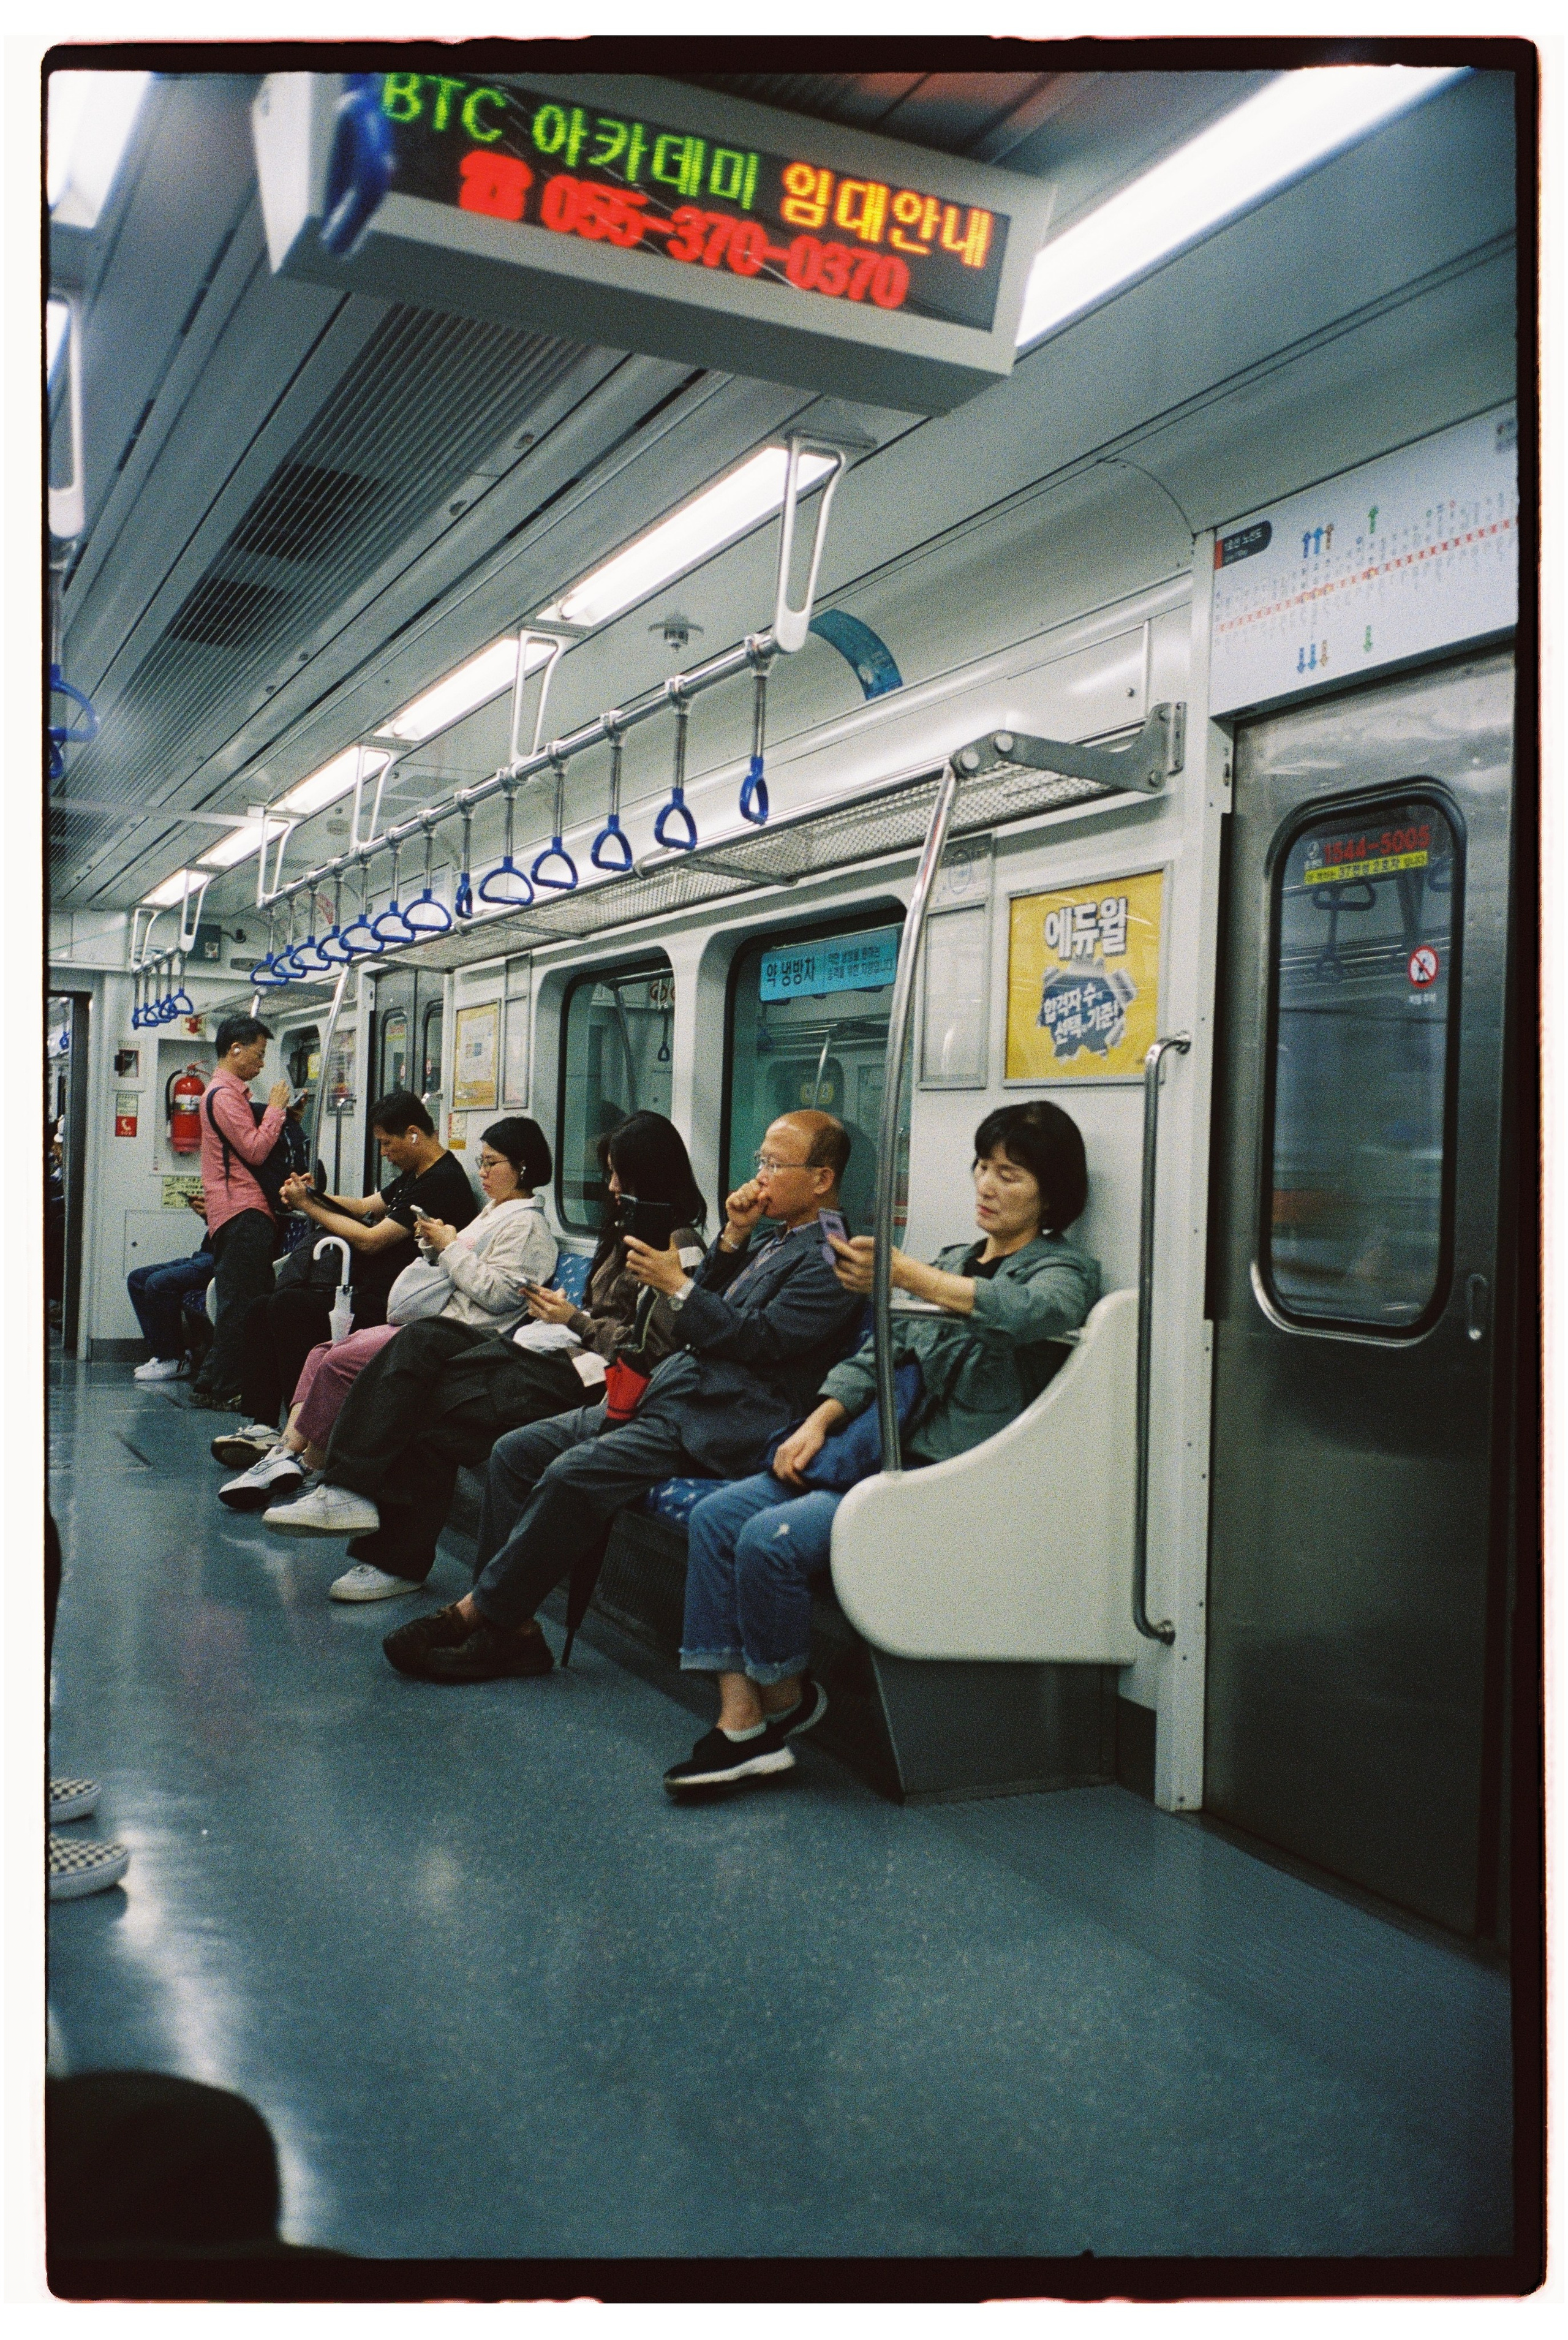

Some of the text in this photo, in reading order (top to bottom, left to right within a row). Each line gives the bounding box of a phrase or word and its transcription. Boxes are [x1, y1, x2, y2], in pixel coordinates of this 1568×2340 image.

[381, 72, 993, 268] BTC 아카데미 임대안내
[540, 174, 911, 310] 055-370-0370
[1324, 825, 1431, 865] 1544-5005
[1044, 896, 1128, 961] 에듀윌
[767, 956, 815, 987] 약 냉방차
[1044, 987, 1080, 1024] 합격자
